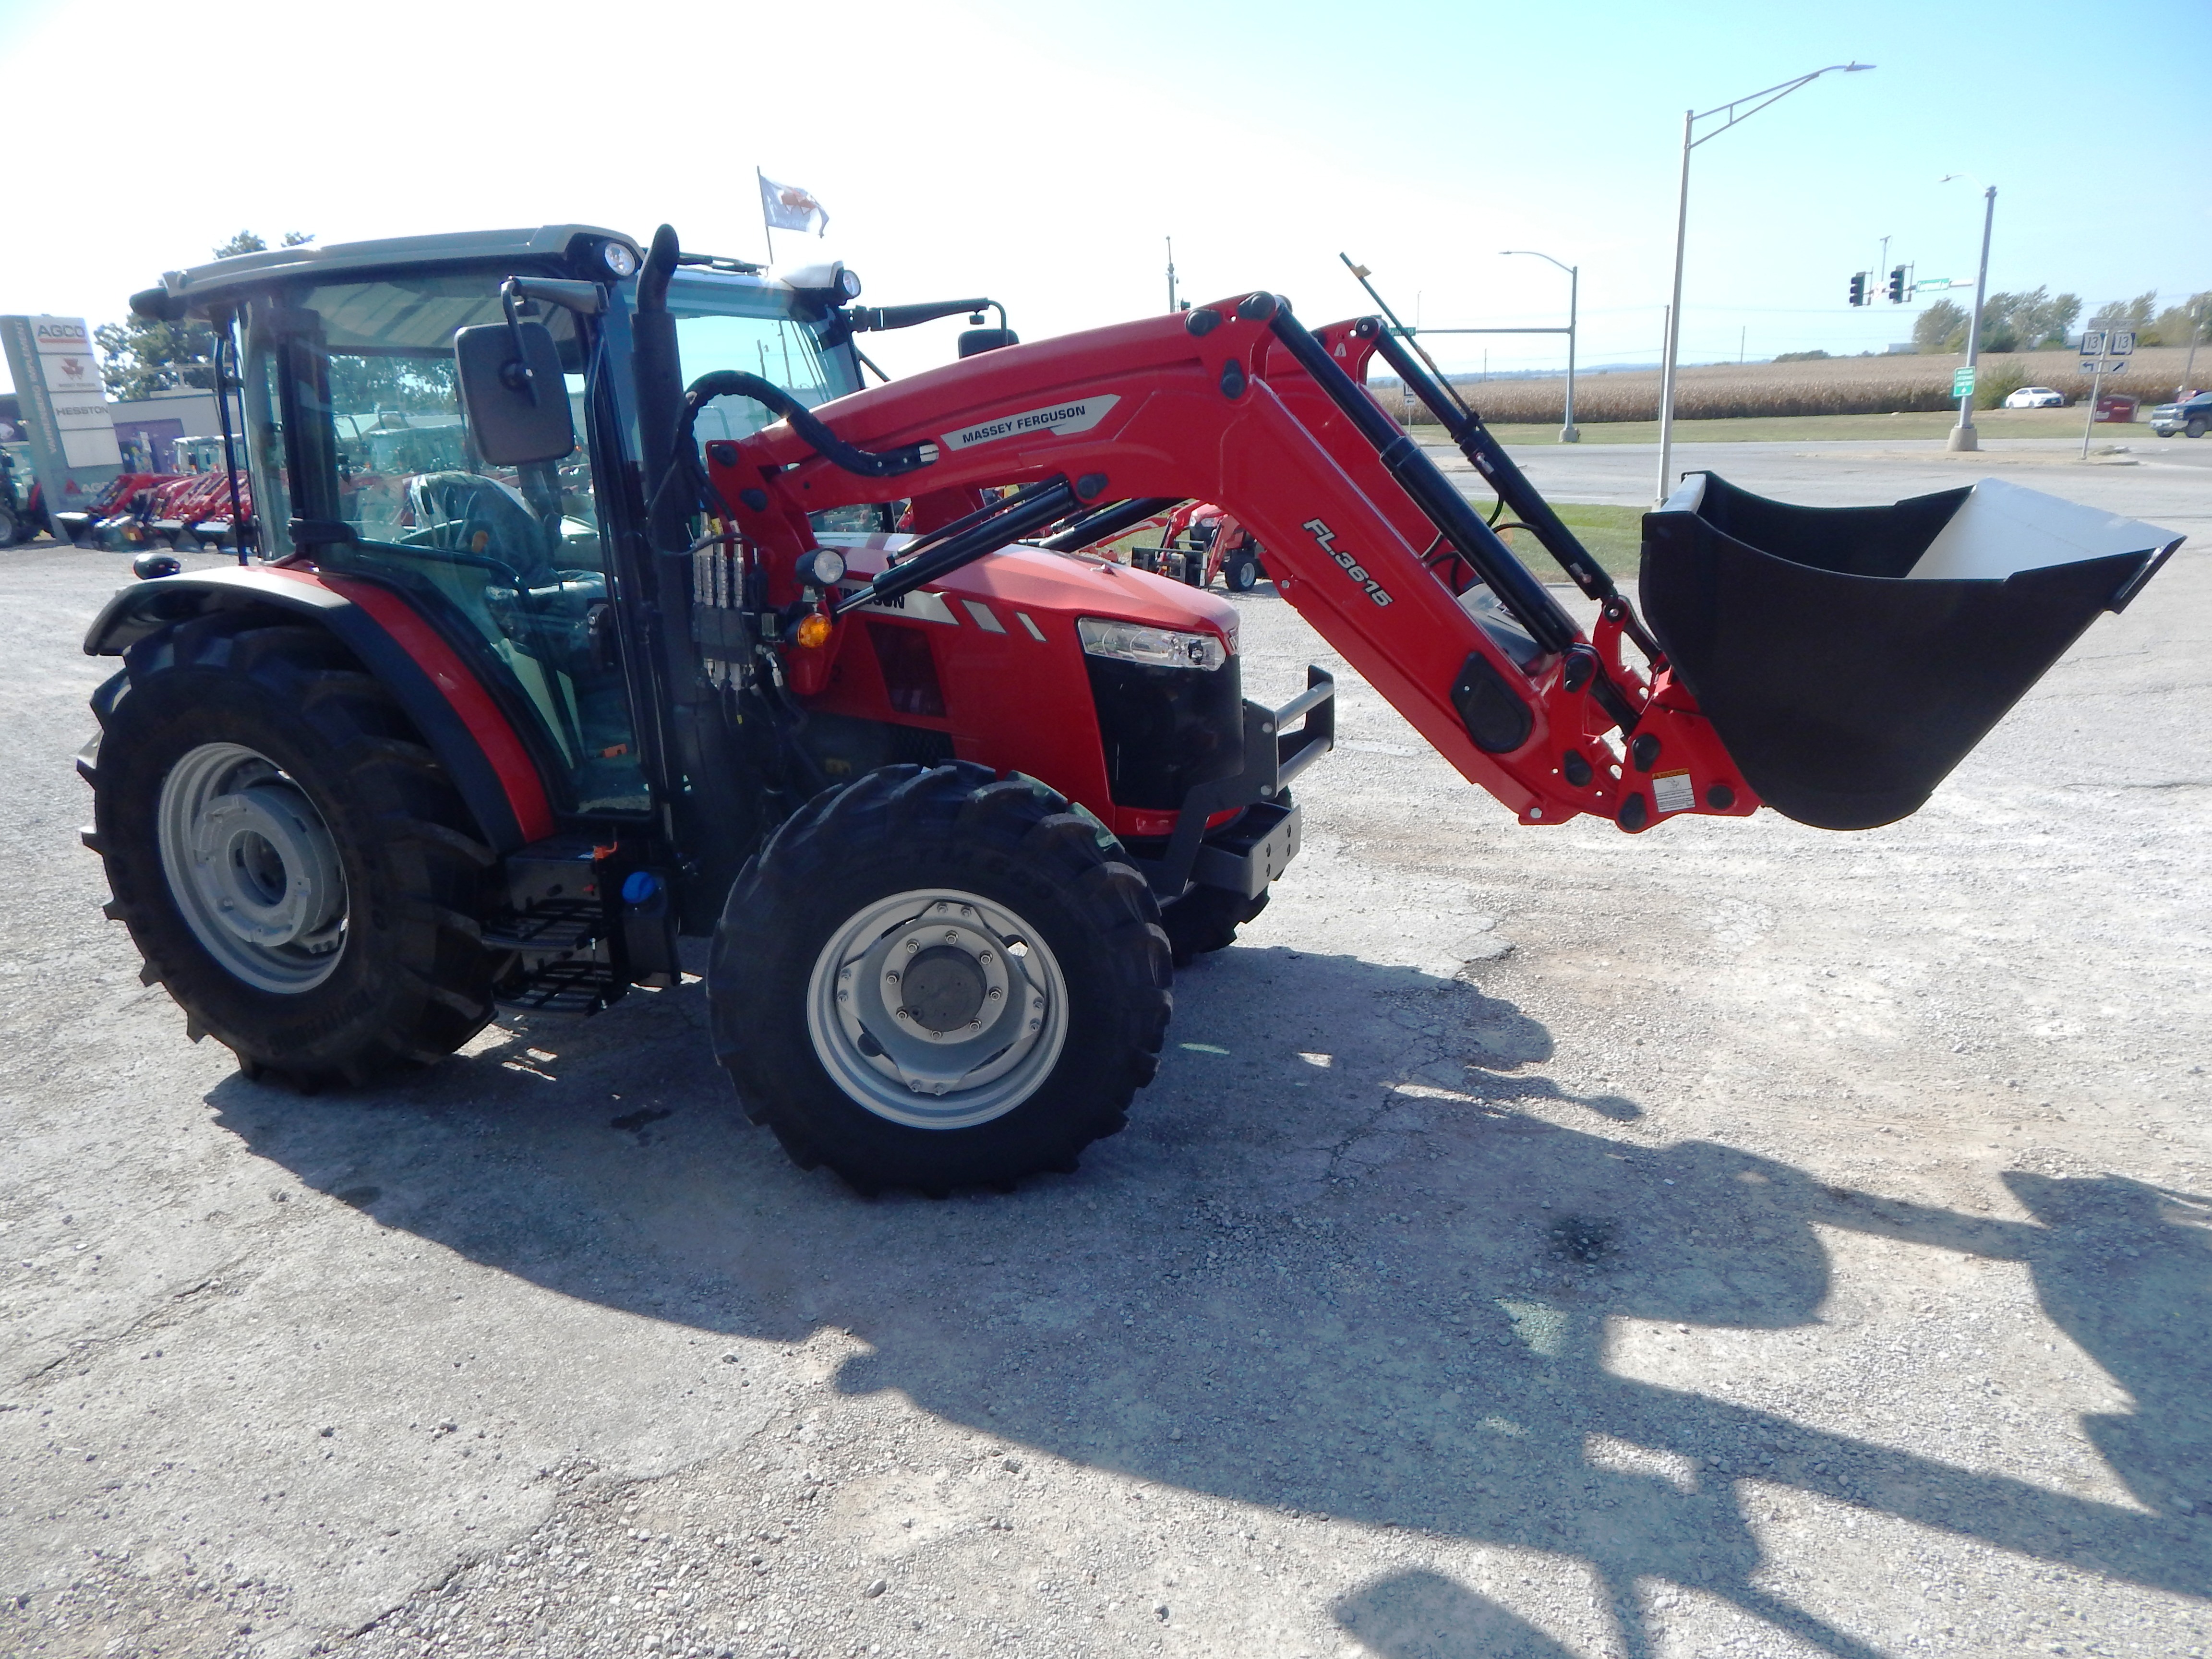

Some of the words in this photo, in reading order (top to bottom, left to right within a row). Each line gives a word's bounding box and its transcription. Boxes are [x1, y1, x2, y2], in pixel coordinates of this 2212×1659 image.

[38, 324, 85, 337] AGCO
[2087, 337, 2098, 349] 13
[2118, 337, 2129, 349] 13
[56, 406, 109, 416] HESSTON
[962, 421, 1012, 444] MASSEY
[1017, 406, 1086, 429] FERGUSON
[1303, 518, 1393, 606] FL.3615
